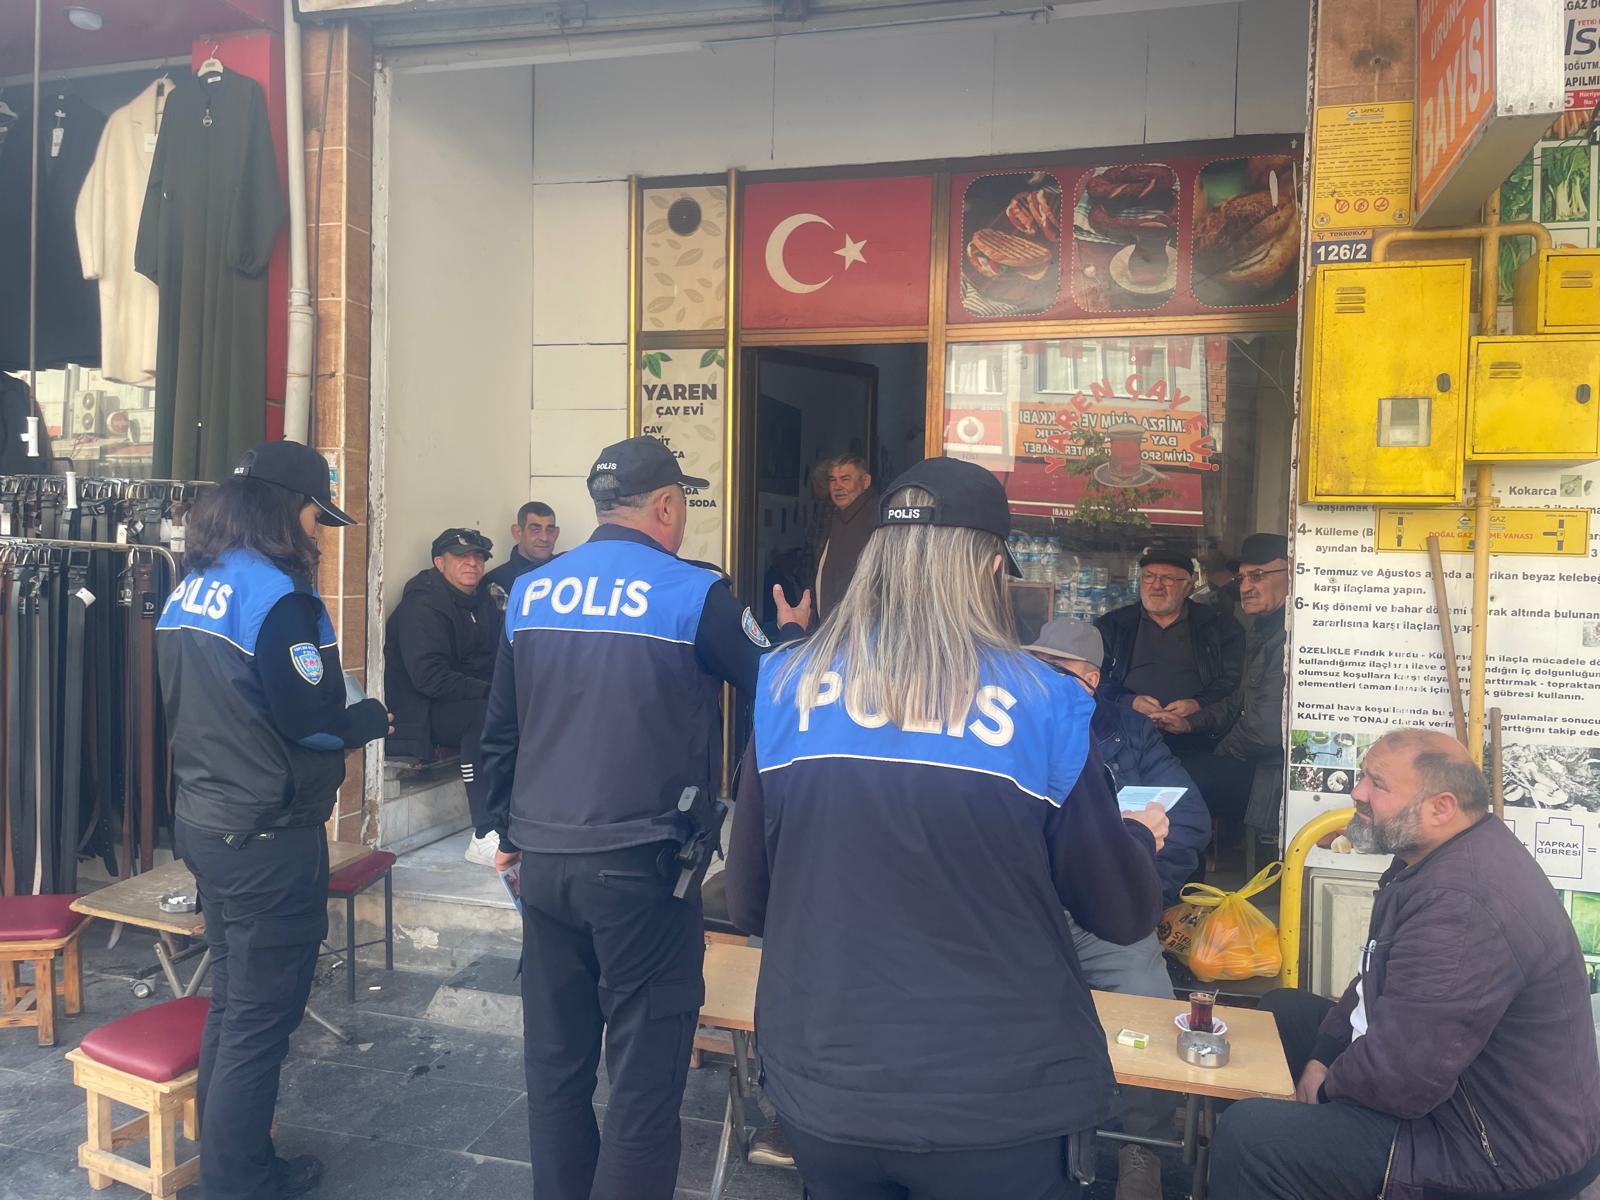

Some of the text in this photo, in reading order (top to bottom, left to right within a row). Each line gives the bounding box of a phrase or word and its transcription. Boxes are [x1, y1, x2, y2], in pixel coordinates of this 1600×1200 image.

[1316, 243, 1367, 262] 126/2
[643, 383, 717, 401] YAREN
[1126, 374, 1191, 410] ÇAY
[655, 401, 704, 419] ÇAY EVİ
[1509, 486, 1557, 496] Kokarca
[689, 499, 717, 508] SODA
[1315, 528, 1359, 539] Külleme
[1457, 531, 1473, 539] GAZ
[1503, 534, 1534, 542] VANASI
[1315, 545, 1358, 556] ayından
[1313, 567, 1358, 577] Temmuz
[1377, 568, 1421, 580] Ağustos
[1522, 572, 1556, 583] beyaz
[1314, 583, 1427, 597] karşı ilaçlama yapın.
[1312, 601, 1329, 612] Kış
[1333, 601, 1372, 612] dönemi
[1375, 604, 1388, 612] ve
[1391, 604, 1422, 613] bahar
[1511, 608, 1551, 618] altında
[1554, 609, 1600, 620] bulunan
[1312, 619, 1369, 629] zararlısına
[1373, 620, 1400, 631] karşı
[1299, 646, 1351, 656] ÖZELİKLE
[1353, 649, 1386, 657] Fındık
[1498, 655, 1529, 665] ilaçla
[1532, 657, 1587, 666] mücadele
[1298, 658, 1367, 669] kullandığımız
[1521, 668, 1532, 677] iç
[1298, 670, 1340, 678] olumsuz
[1343, 671, 1391, 682] koşullara
[1486, 678, 1538, 687] arttırmak
[1298, 681, 1356, 690] elementleri
[1493, 689, 1534, 700] gübresi
[1537, 690, 1585, 701] kullanın.
[1297, 701, 1335, 711] Normal
[1297, 712, 1335, 722] KALİTE
[1353, 716, 1389, 725] TONAJ
[1501, 725, 1545, 735] arttığını
[1548, 727, 1577, 737] takip
[1537, 847, 1582, 858] GÜBRESİ
[1539, 840, 1580, 850] YAPRAK
